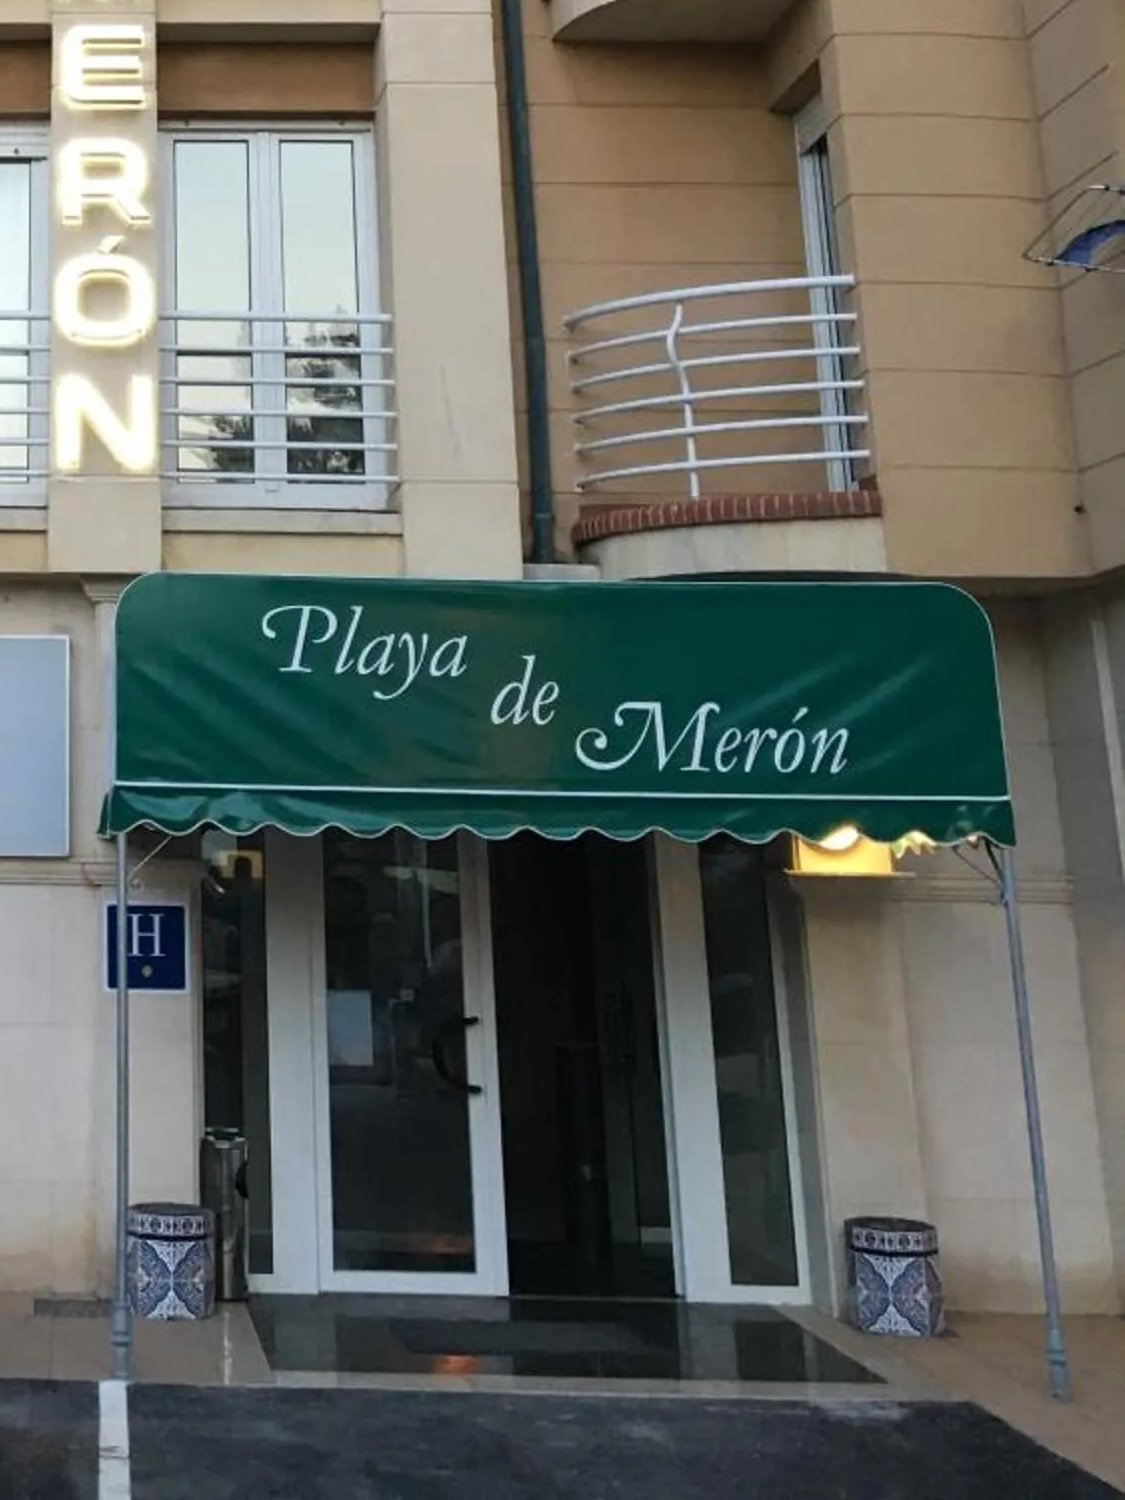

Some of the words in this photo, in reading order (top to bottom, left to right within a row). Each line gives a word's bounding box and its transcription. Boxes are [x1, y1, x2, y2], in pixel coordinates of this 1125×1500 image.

[261, 604, 469, 700] Playa
[489, 654, 560, 726] de
[574, 700, 850, 774] Merón
[126, 912, 167, 957] H
